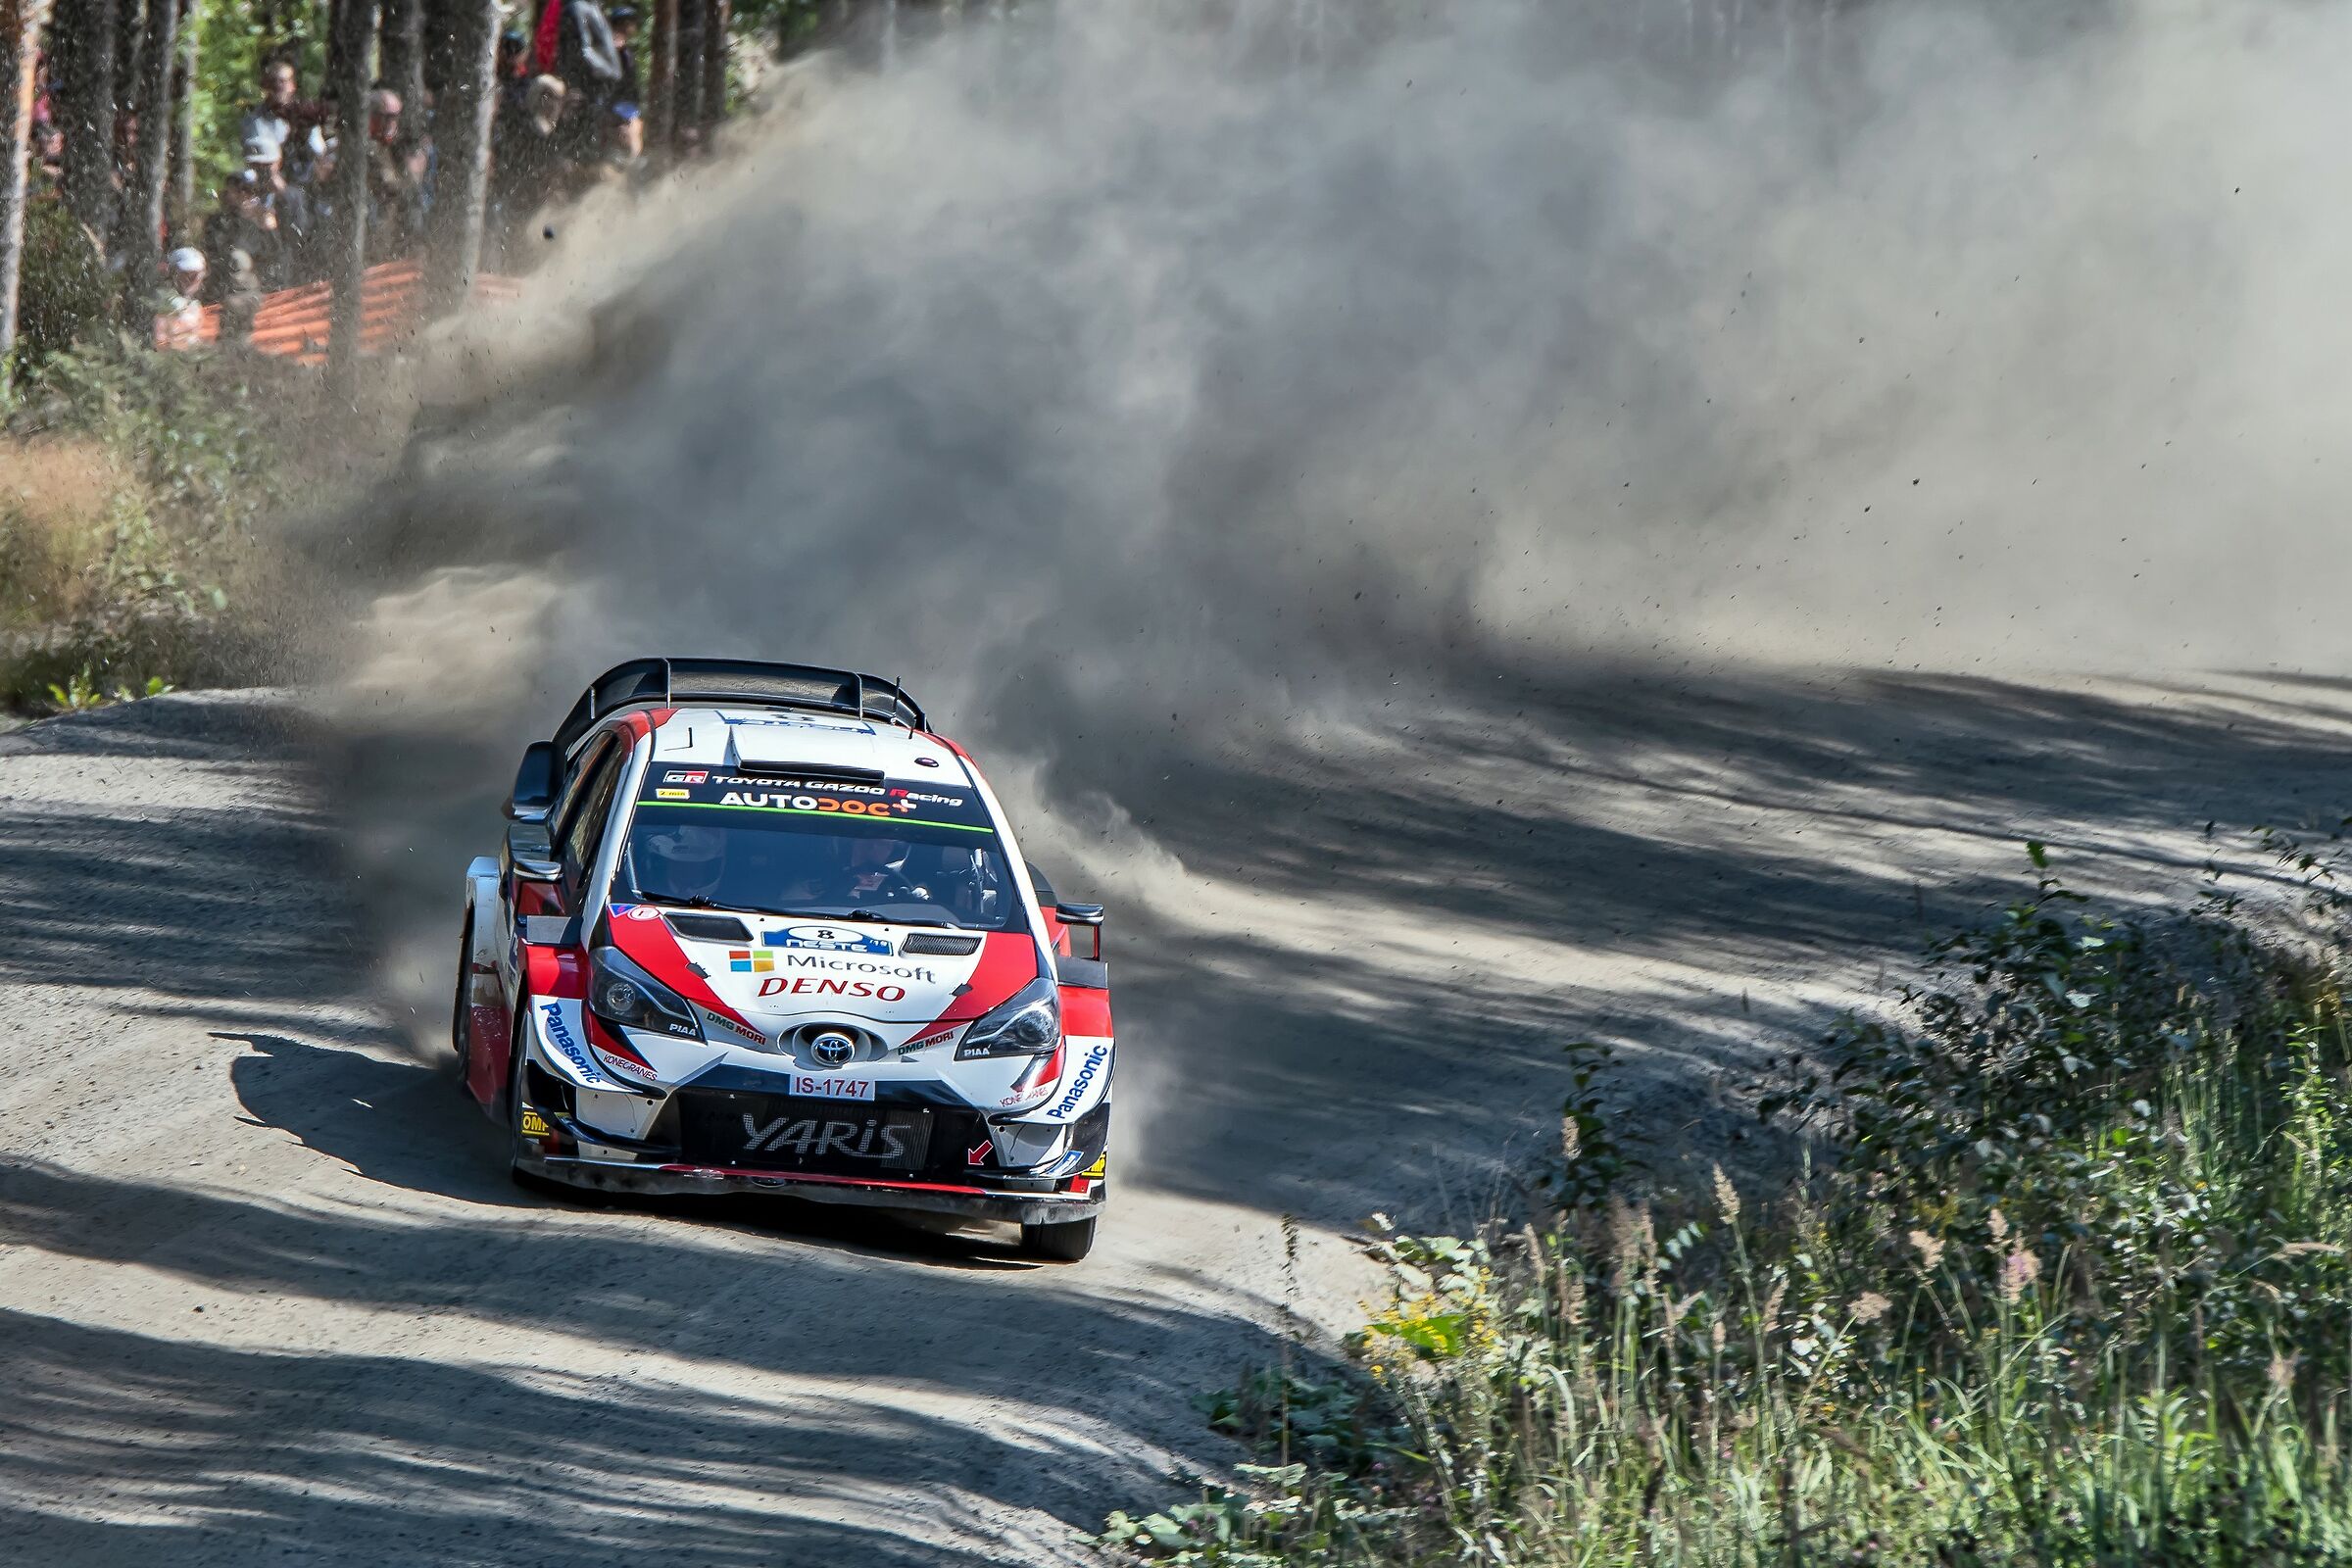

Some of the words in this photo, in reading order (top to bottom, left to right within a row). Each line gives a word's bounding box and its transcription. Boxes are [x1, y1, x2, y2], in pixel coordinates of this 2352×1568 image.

[711, 775, 801, 789] TOYOTA
[805, 780, 886, 796] GAZOO
[889, 788, 963, 808] Racing
[718, 791, 891, 816] AUTODOC
[817, 929, 835, 940] 8
[787, 955, 936, 984] Microsoft
[758, 977, 906, 1002] DENSO
[669, 1023, 697, 1036] PIAA
[706, 1011, 735, 1030] DMG
[735, 1024, 767, 1046] MORI
[539, 1003, 602, 1084] Panasonic
[898, 1041, 924, 1055] DMG
[925, 1030, 955, 1047] MORI
[963, 1047, 991, 1057] PIAA
[603, 1054, 659, 1081] KONECRANES
[795, 1076, 869, 1099] IS-1747
[1047, 1045, 1108, 1120] Panasonic
